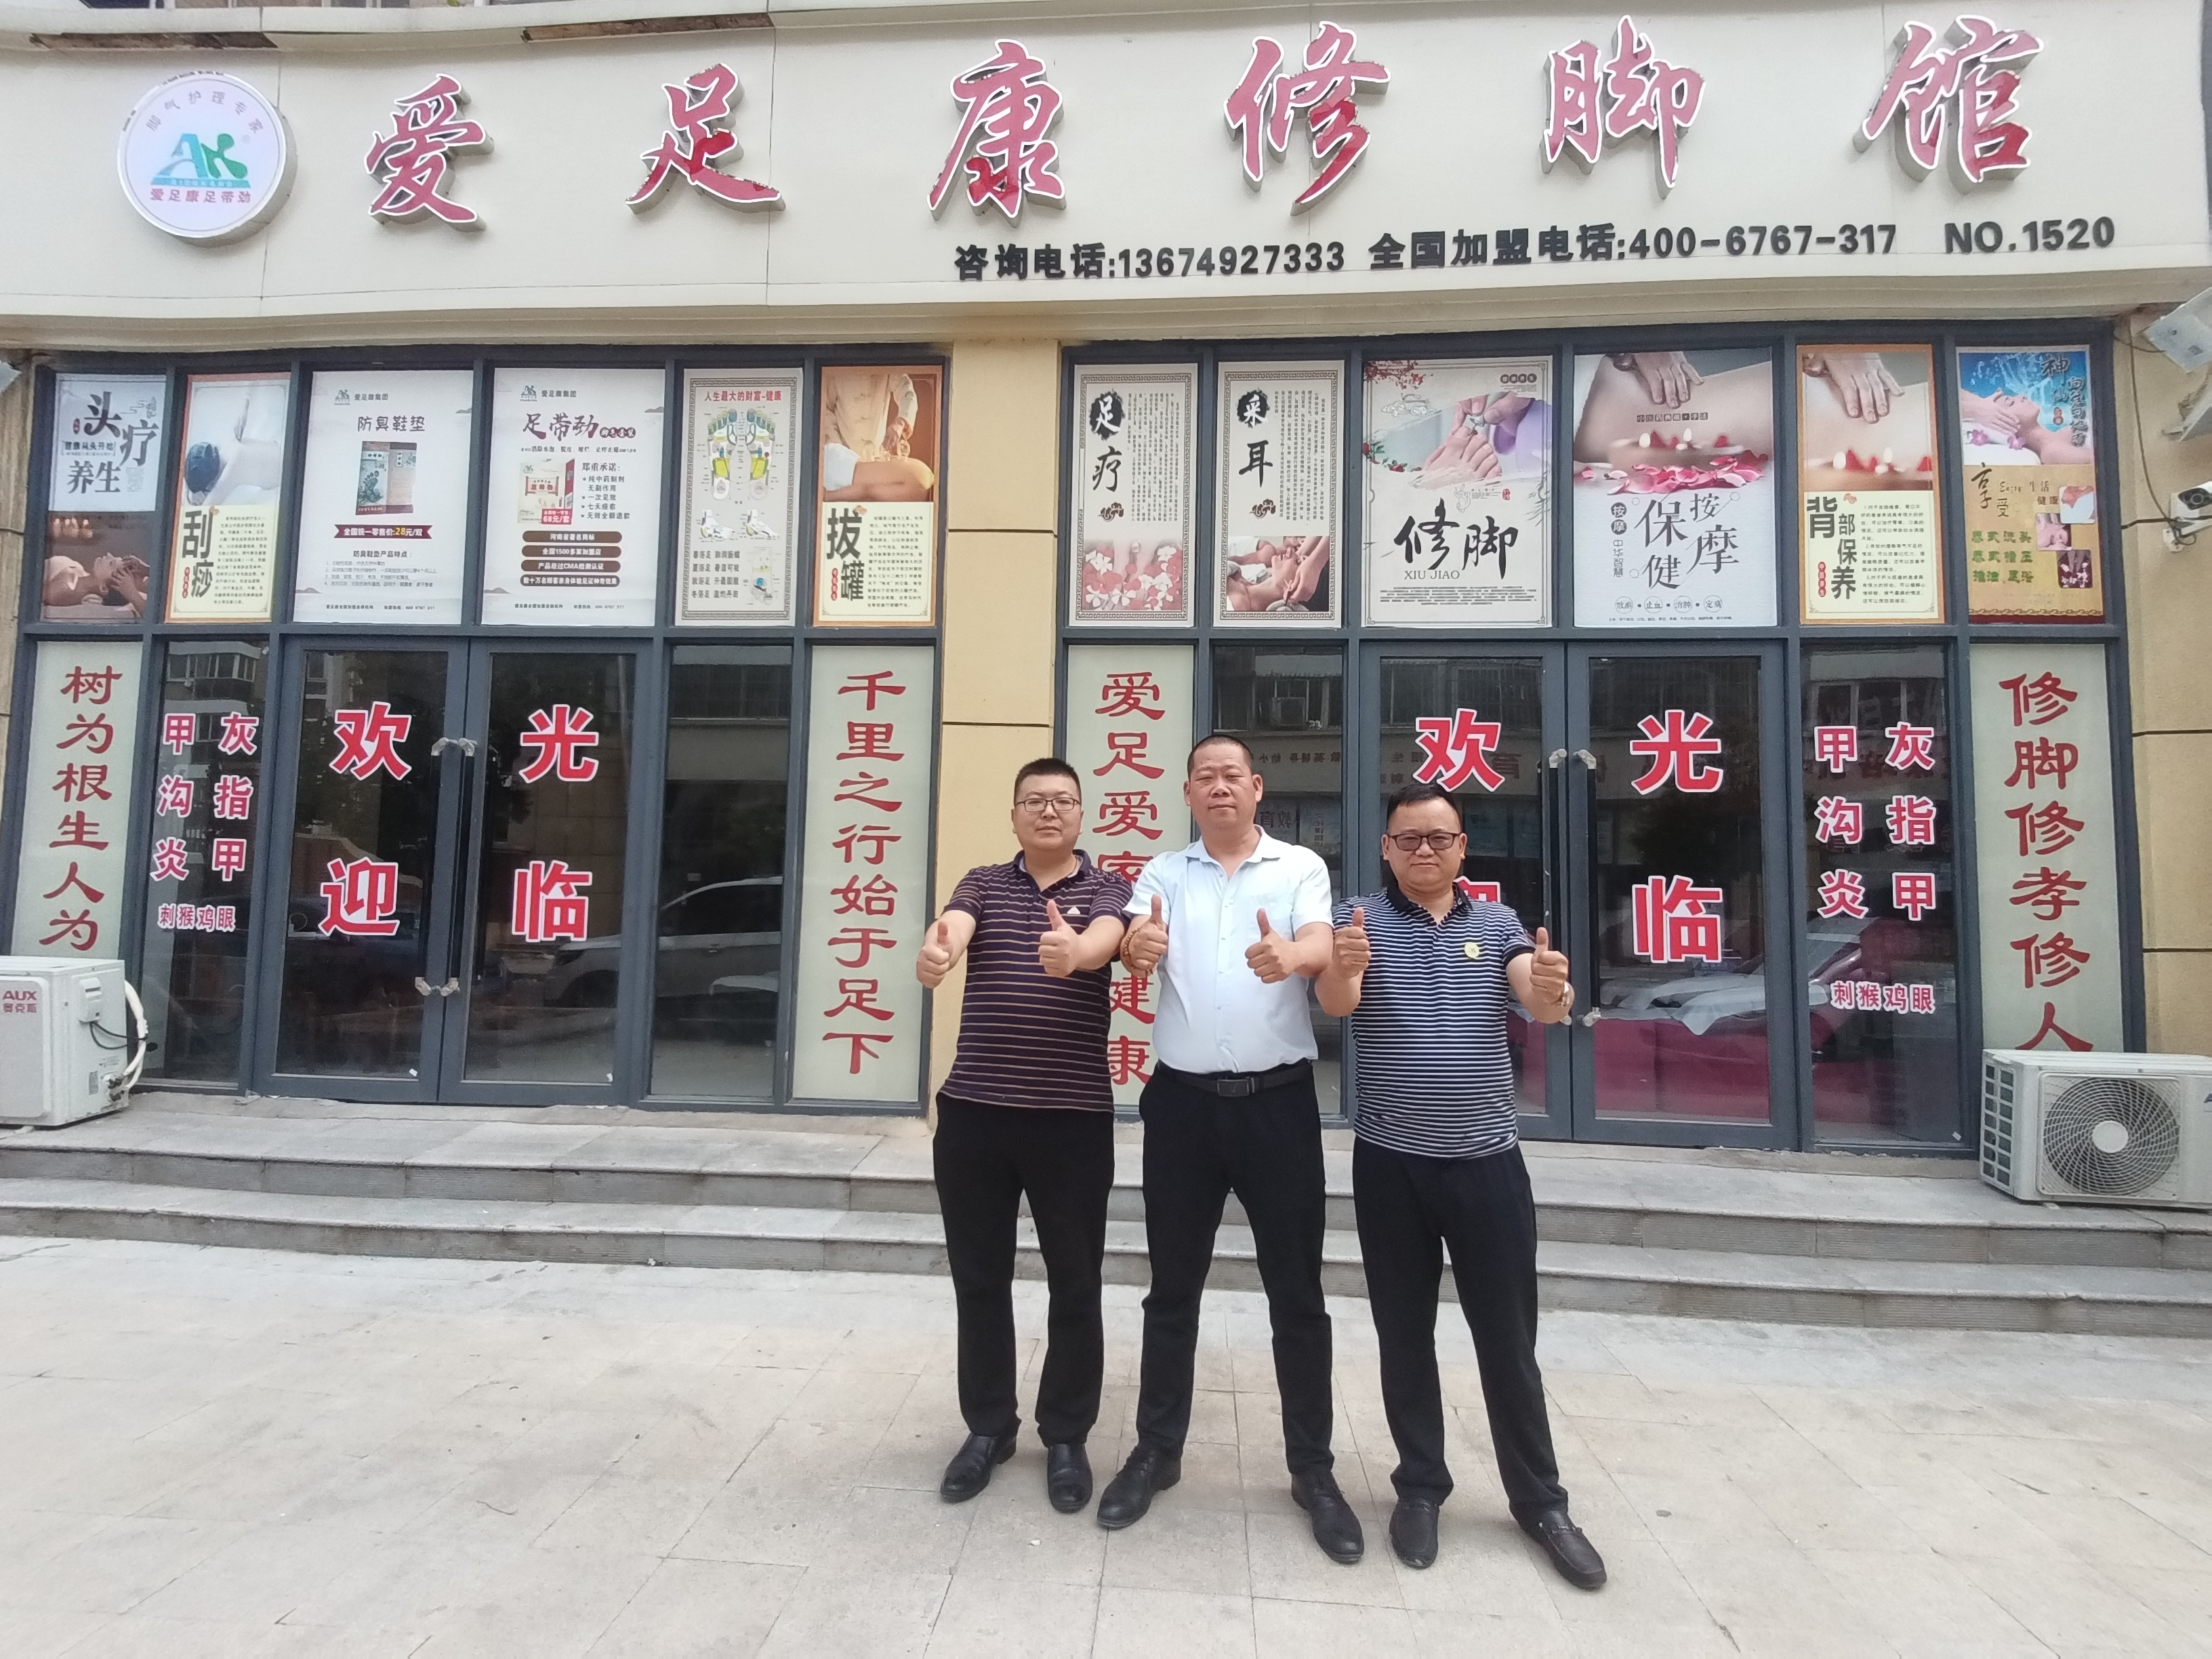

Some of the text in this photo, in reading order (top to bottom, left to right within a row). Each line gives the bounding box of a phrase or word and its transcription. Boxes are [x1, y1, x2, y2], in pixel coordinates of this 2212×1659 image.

[365, 14, 2043, 218] 爱足康修脚馆
[150, 188, 251, 203] 爱足康足带劲
[954, 216, 2116, 281] 咨询电话:13674927333 全国加盟电话:400-6767-317 NO.1520
[357, 415, 426, 432] 防臭鞋垫
[523, 412, 599, 441] 足带劲
[1092, 395, 1122, 493] 足疗
[1239, 394, 1273, 488] 采耳
[67, 460, 121, 494] 养生
[182, 510, 214, 598] 刮痧
[826, 508, 865, 601] 拔罐
[1393, 497, 1519, 579] 修脚
[1404, 570, 1460, 580] XIU JIAO
[1613, 539, 1624, 577] 中华智慧
[39, 665, 123, 951] 树为根生人为
[150, 713, 197, 881] 甲沟炎
[211, 712, 259, 882] 灰指甲
[1814, 726, 1868, 919] 甲沟炎
[1885, 722, 1937, 920] 灰指甲
[822, 670, 907, 1075] 千里之行始于足下
[1999, 671, 2093, 1052] 修脚修孝修人
[157, 903, 237, 933] 刺猴鸡眼
[2, 990, 37, 1000] AUX
[1830, 980, 1936, 1015] 刺猴鸡眼
